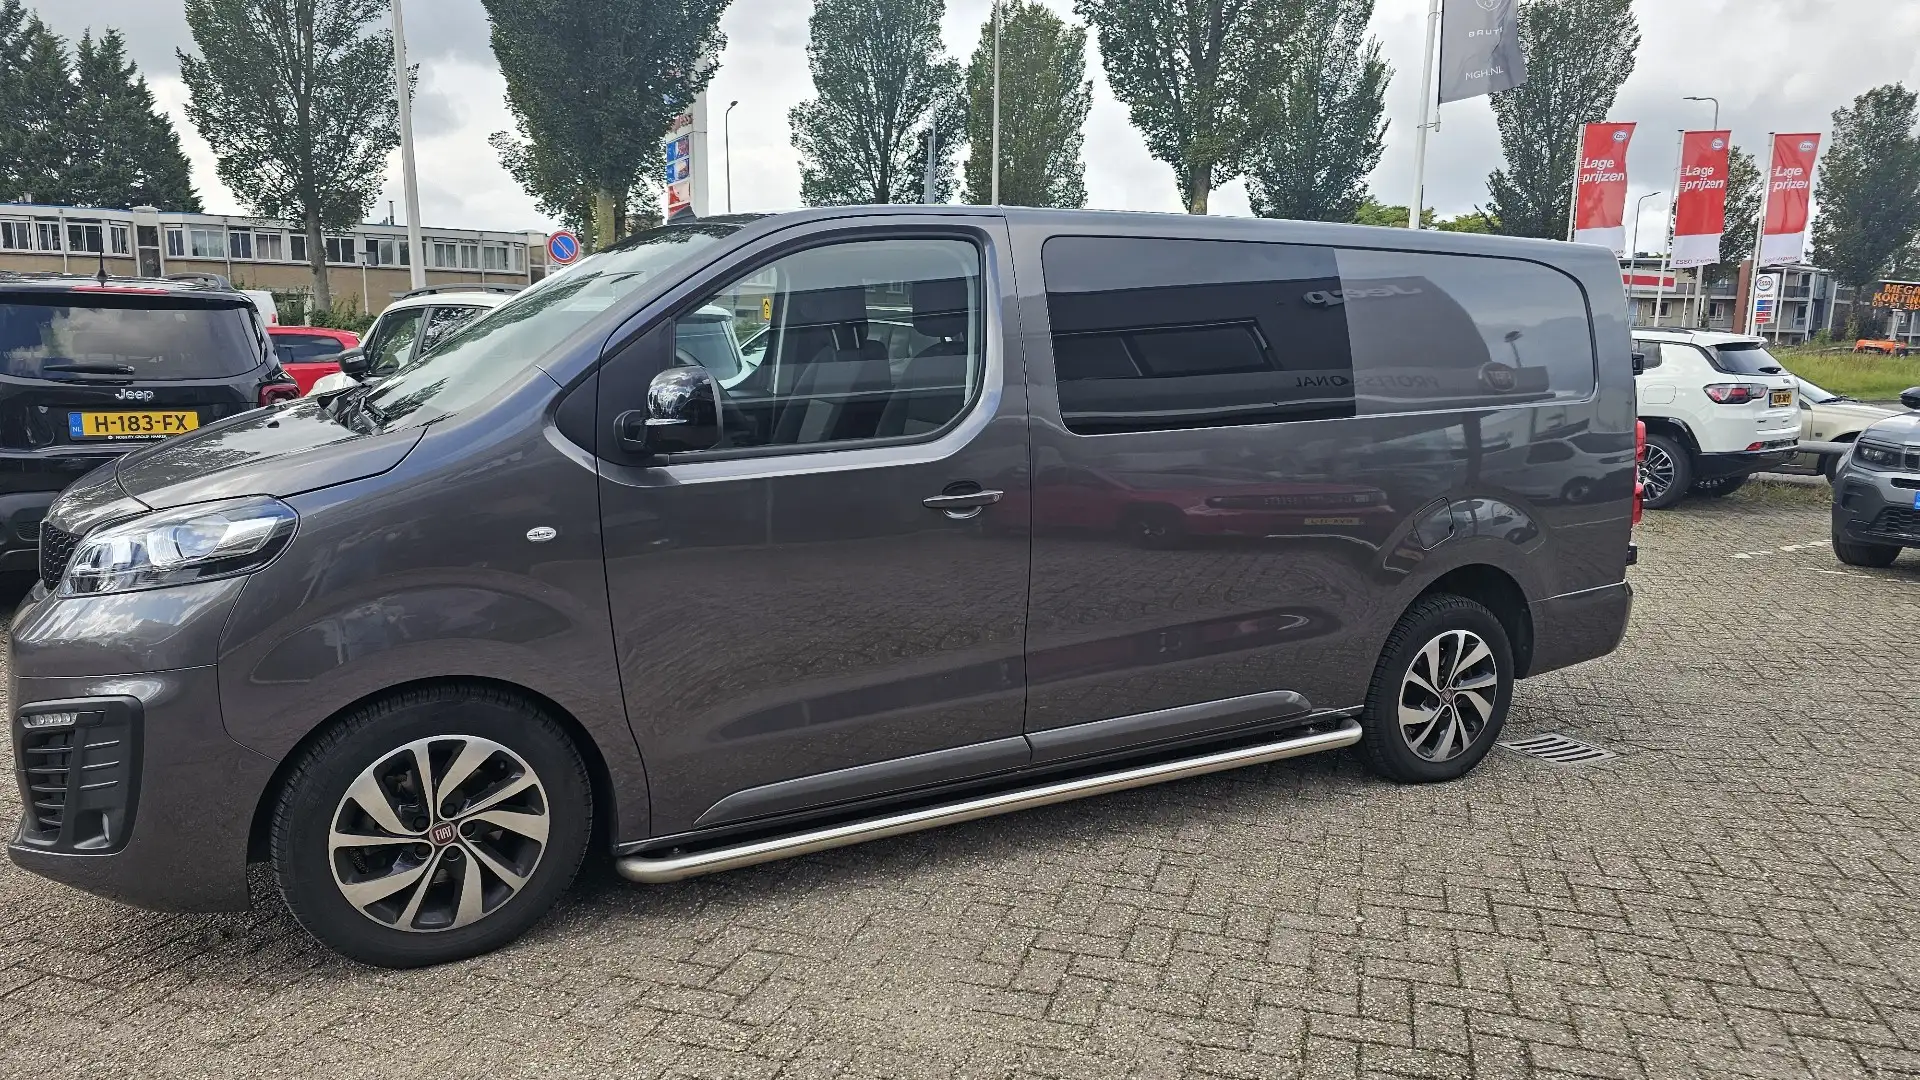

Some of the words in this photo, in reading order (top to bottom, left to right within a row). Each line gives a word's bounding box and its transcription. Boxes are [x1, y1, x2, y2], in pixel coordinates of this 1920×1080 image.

[1465, 66, 1504, 80] MGH.NL
[1583, 157, 1615, 170] Lage
[1685, 164, 1715, 177] Lage
[1582, 170, 1625, 185] prijzen
[1683, 177, 1725, 193] prijzen
[1872, 292, 1920, 304] KORTIN
[115, 388, 154, 401] Jeep
[94, 414, 188, 432] H-183-FX
[435, 825, 452, 841] FIAT
